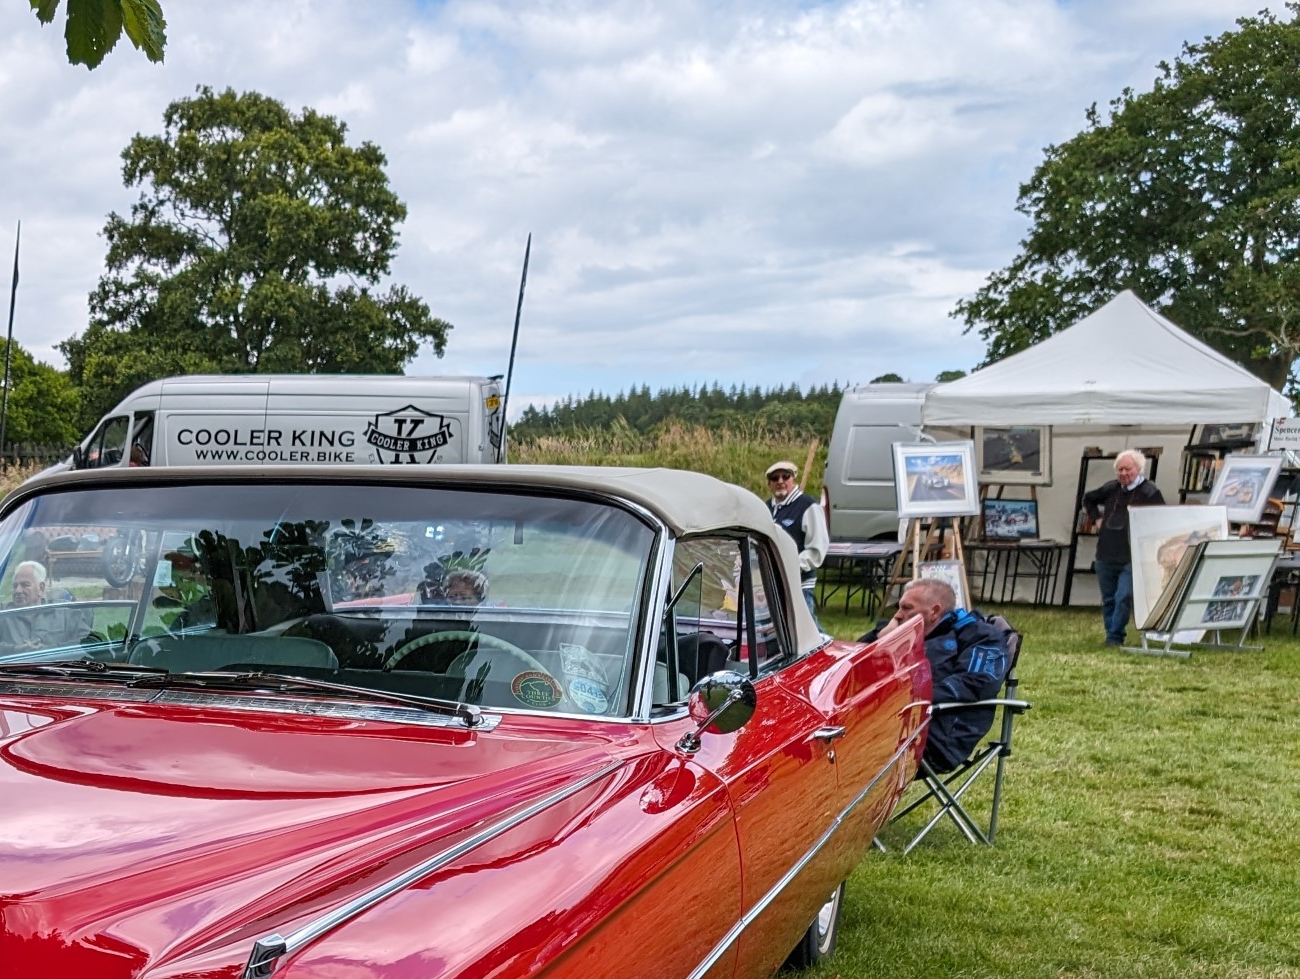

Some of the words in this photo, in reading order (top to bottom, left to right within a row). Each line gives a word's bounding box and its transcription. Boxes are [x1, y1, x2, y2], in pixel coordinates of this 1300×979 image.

[177, 429, 283, 446] COOLER
[292, 430, 355, 448] KING
[370, 434, 410, 451] COOLER
[416, 434, 444, 450] KING
[195, 450, 355, 462] WWW.COOLER.BIKE
